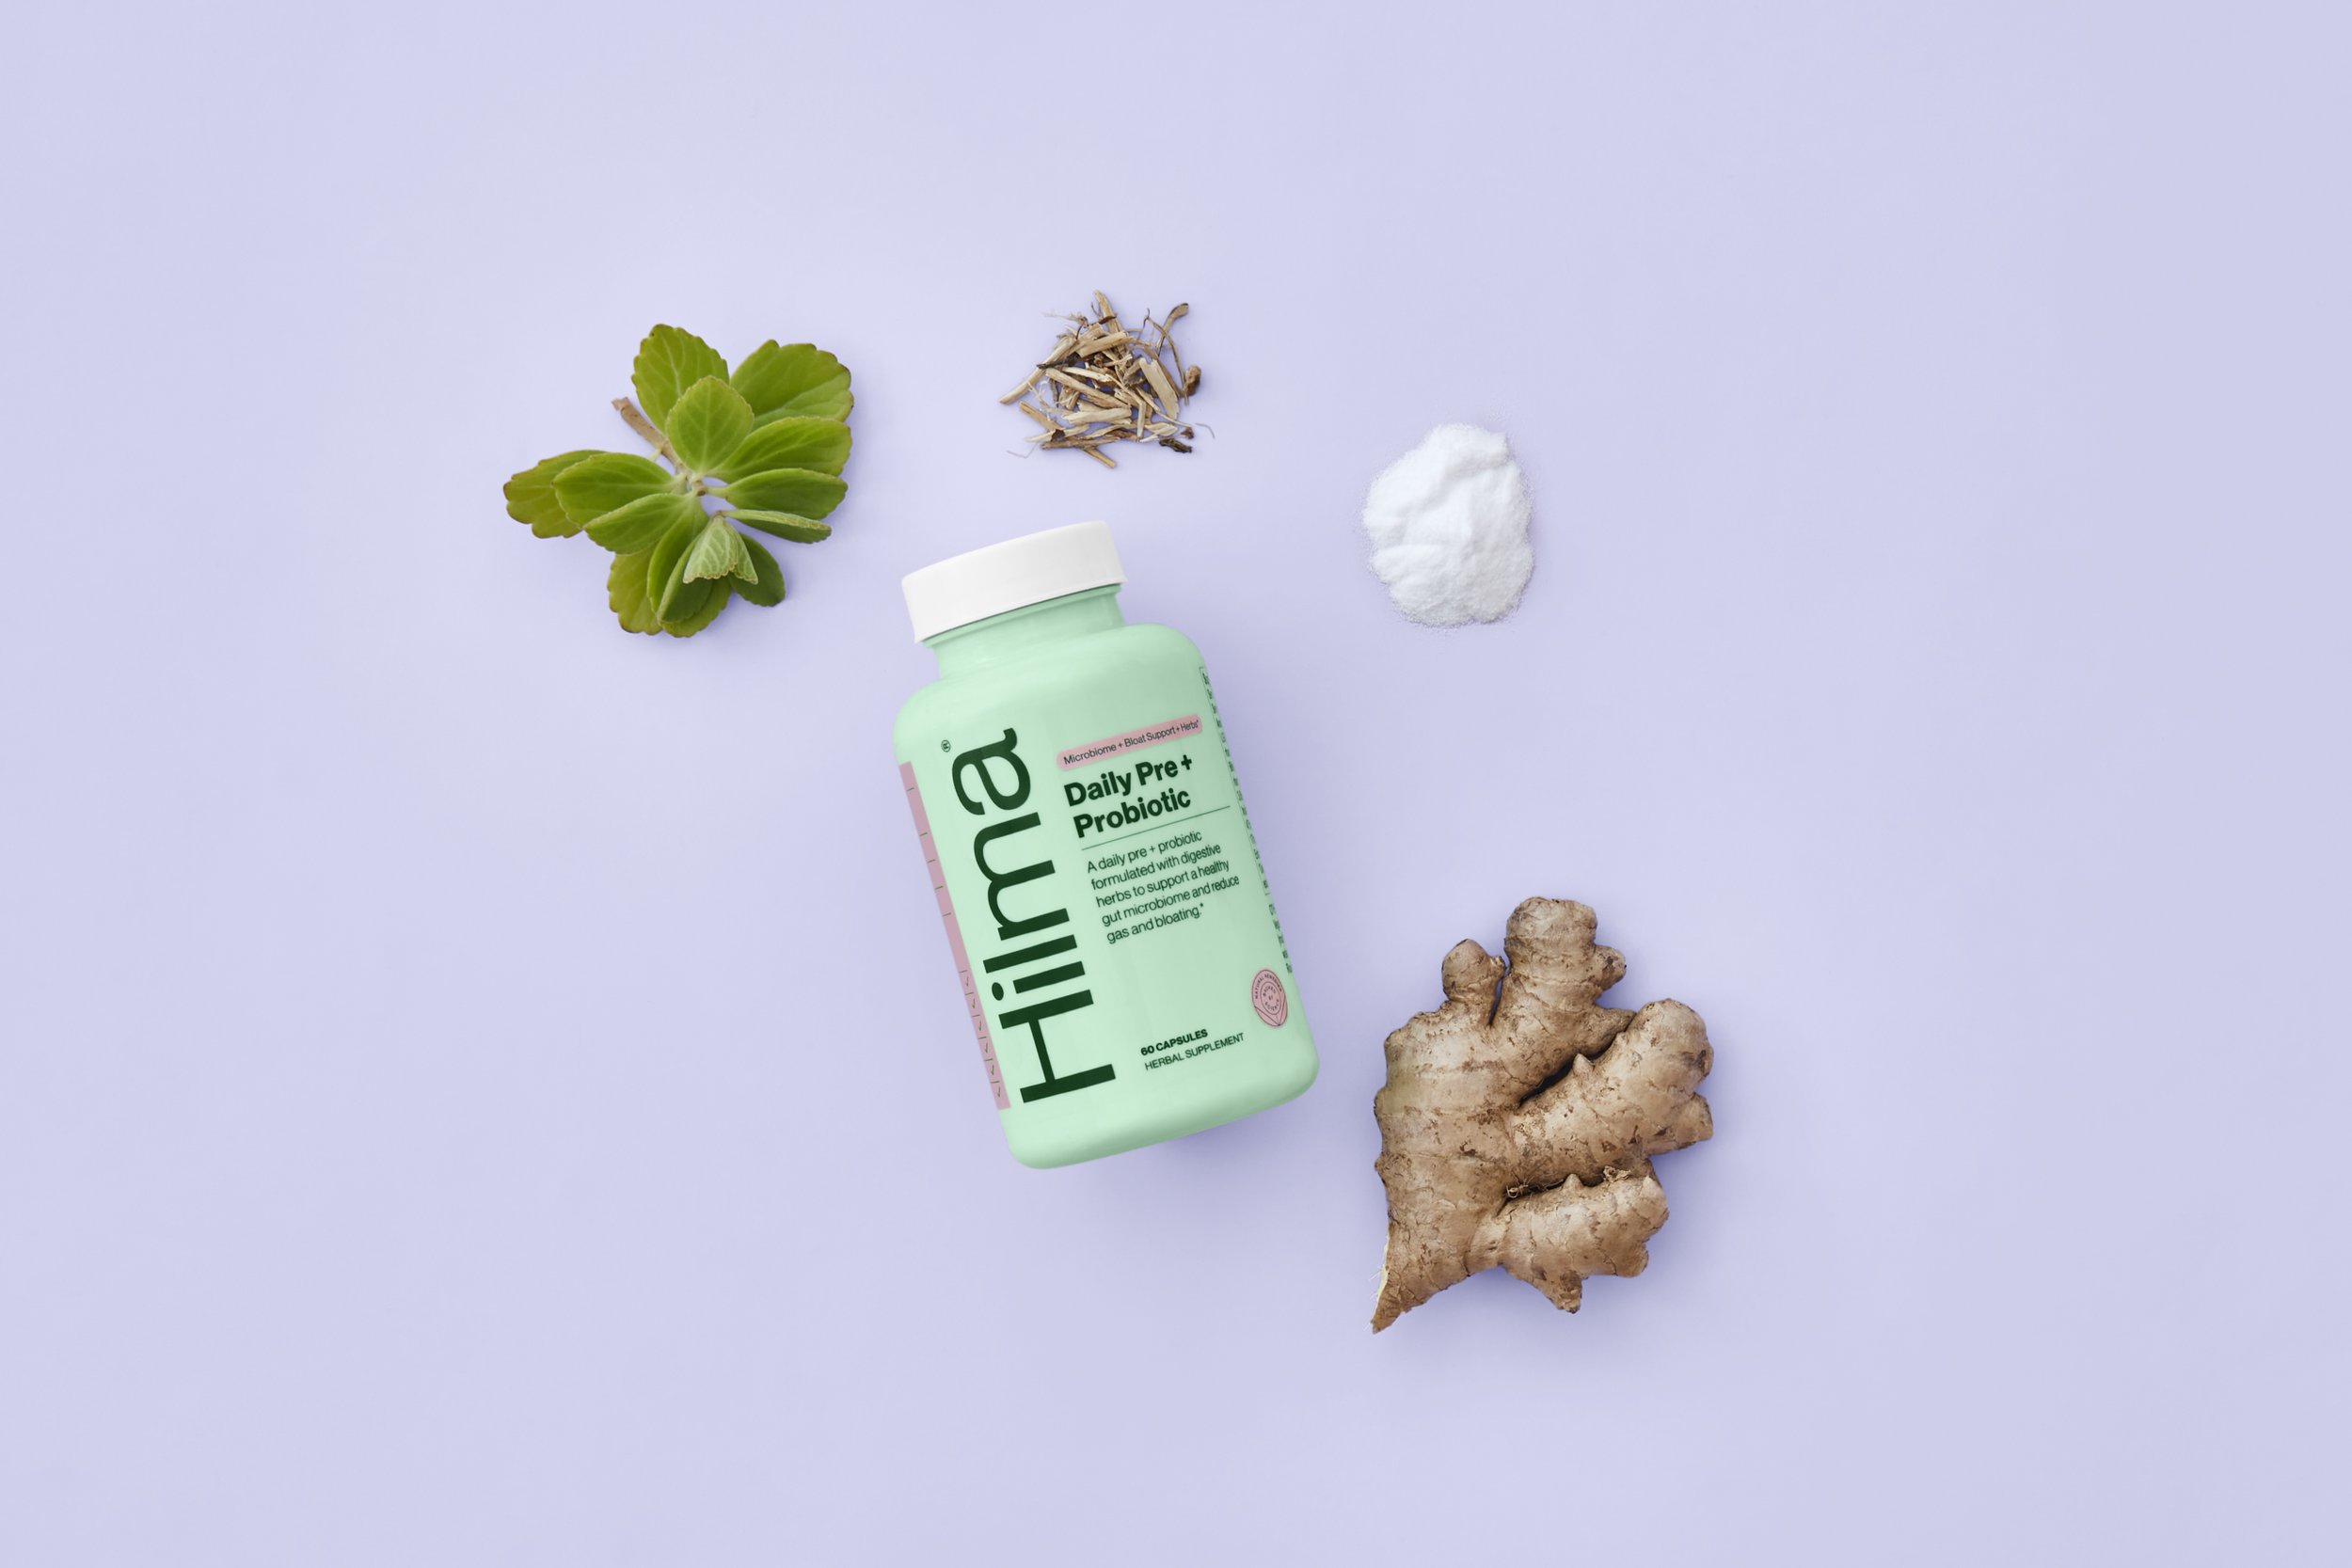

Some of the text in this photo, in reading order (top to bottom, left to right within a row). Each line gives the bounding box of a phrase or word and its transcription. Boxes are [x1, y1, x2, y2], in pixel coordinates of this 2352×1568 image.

[1064, 744, 1117, 765] Microbiome
[1124, 735, 1147, 748] Bloat
[1146, 727, 1176, 741] Support
[1064, 754, 1192, 807] Daily Pre +
[1073, 788, 1191, 838] Probiotic
[1088, 862, 1097, 873] A
[1099, 852, 1125, 870] daily
[1128, 847, 1148, 863] pre
[1158, 831, 1202, 854] probiotic
[1091, 844, 1221, 890] formulated with digestive
[1096, 860, 1230, 908] herbs to support a healthy
[1102, 875, 1240, 927] gut microbiome and reduce
[952, 727, 1116, 1103] Hilma
[1106, 927, 1130, 944] gas
[1131, 918, 1154, 935] and
[1140, 1029, 1208, 1055] 60 CAPSULES
[1144, 1032, 1244, 1070] HERBAL SUPPLEMENT
